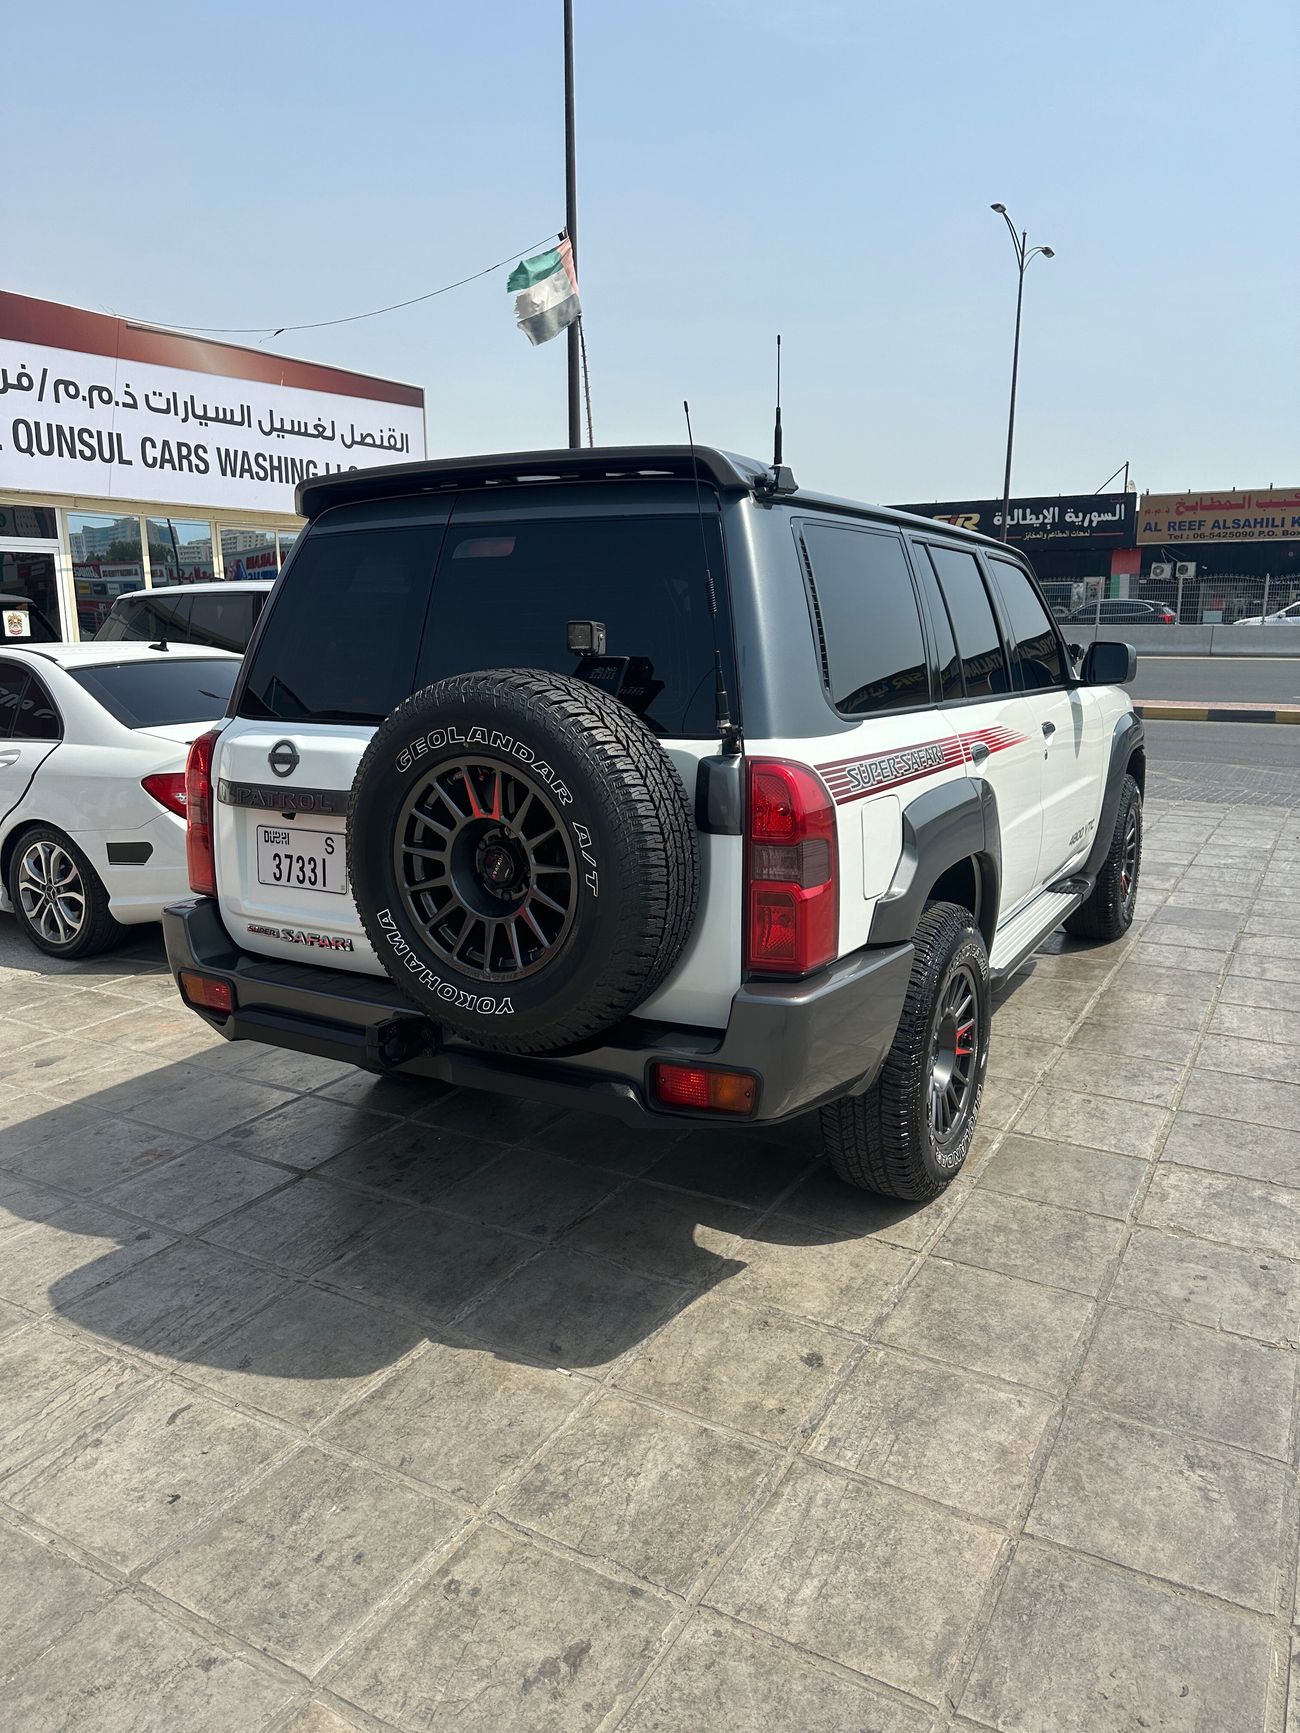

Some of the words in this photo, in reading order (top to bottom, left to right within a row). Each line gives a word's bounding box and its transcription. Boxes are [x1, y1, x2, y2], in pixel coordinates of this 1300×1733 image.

[144, 390, 252, 428] السيارات
[257, 409, 335, 441] لغسيل
[341, 423, 409, 454] القنصل
[12, 418, 133, 466] QUNSUL
[141, 436, 210, 475] CARS
[216, 447, 318, 485] WASHING
[1064, 503, 1125, 527] السورية
[1143, 522, 1162, 532] AL
[1167, 519, 1207, 532] REEF
[1211, 516, 1285, 530] ALSAHILI
[1193, 530, 1254, 539] 06-5425090
[845, 757, 900, 790] SUPER
[899, 744, 945, 773] SAFARI
[236, 787, 333, 811] PATROL
[394, 726, 576, 806] GEOLANDAR
[572, 821, 600, 898] A/T
[324, 836, 335, 855] S
[272, 852, 327, 888] 37331
[247, 923, 280, 938] SUPER
[280, 928, 355, 952] SAFARI
[376, 907, 516, 1016] YOKOHAMA
